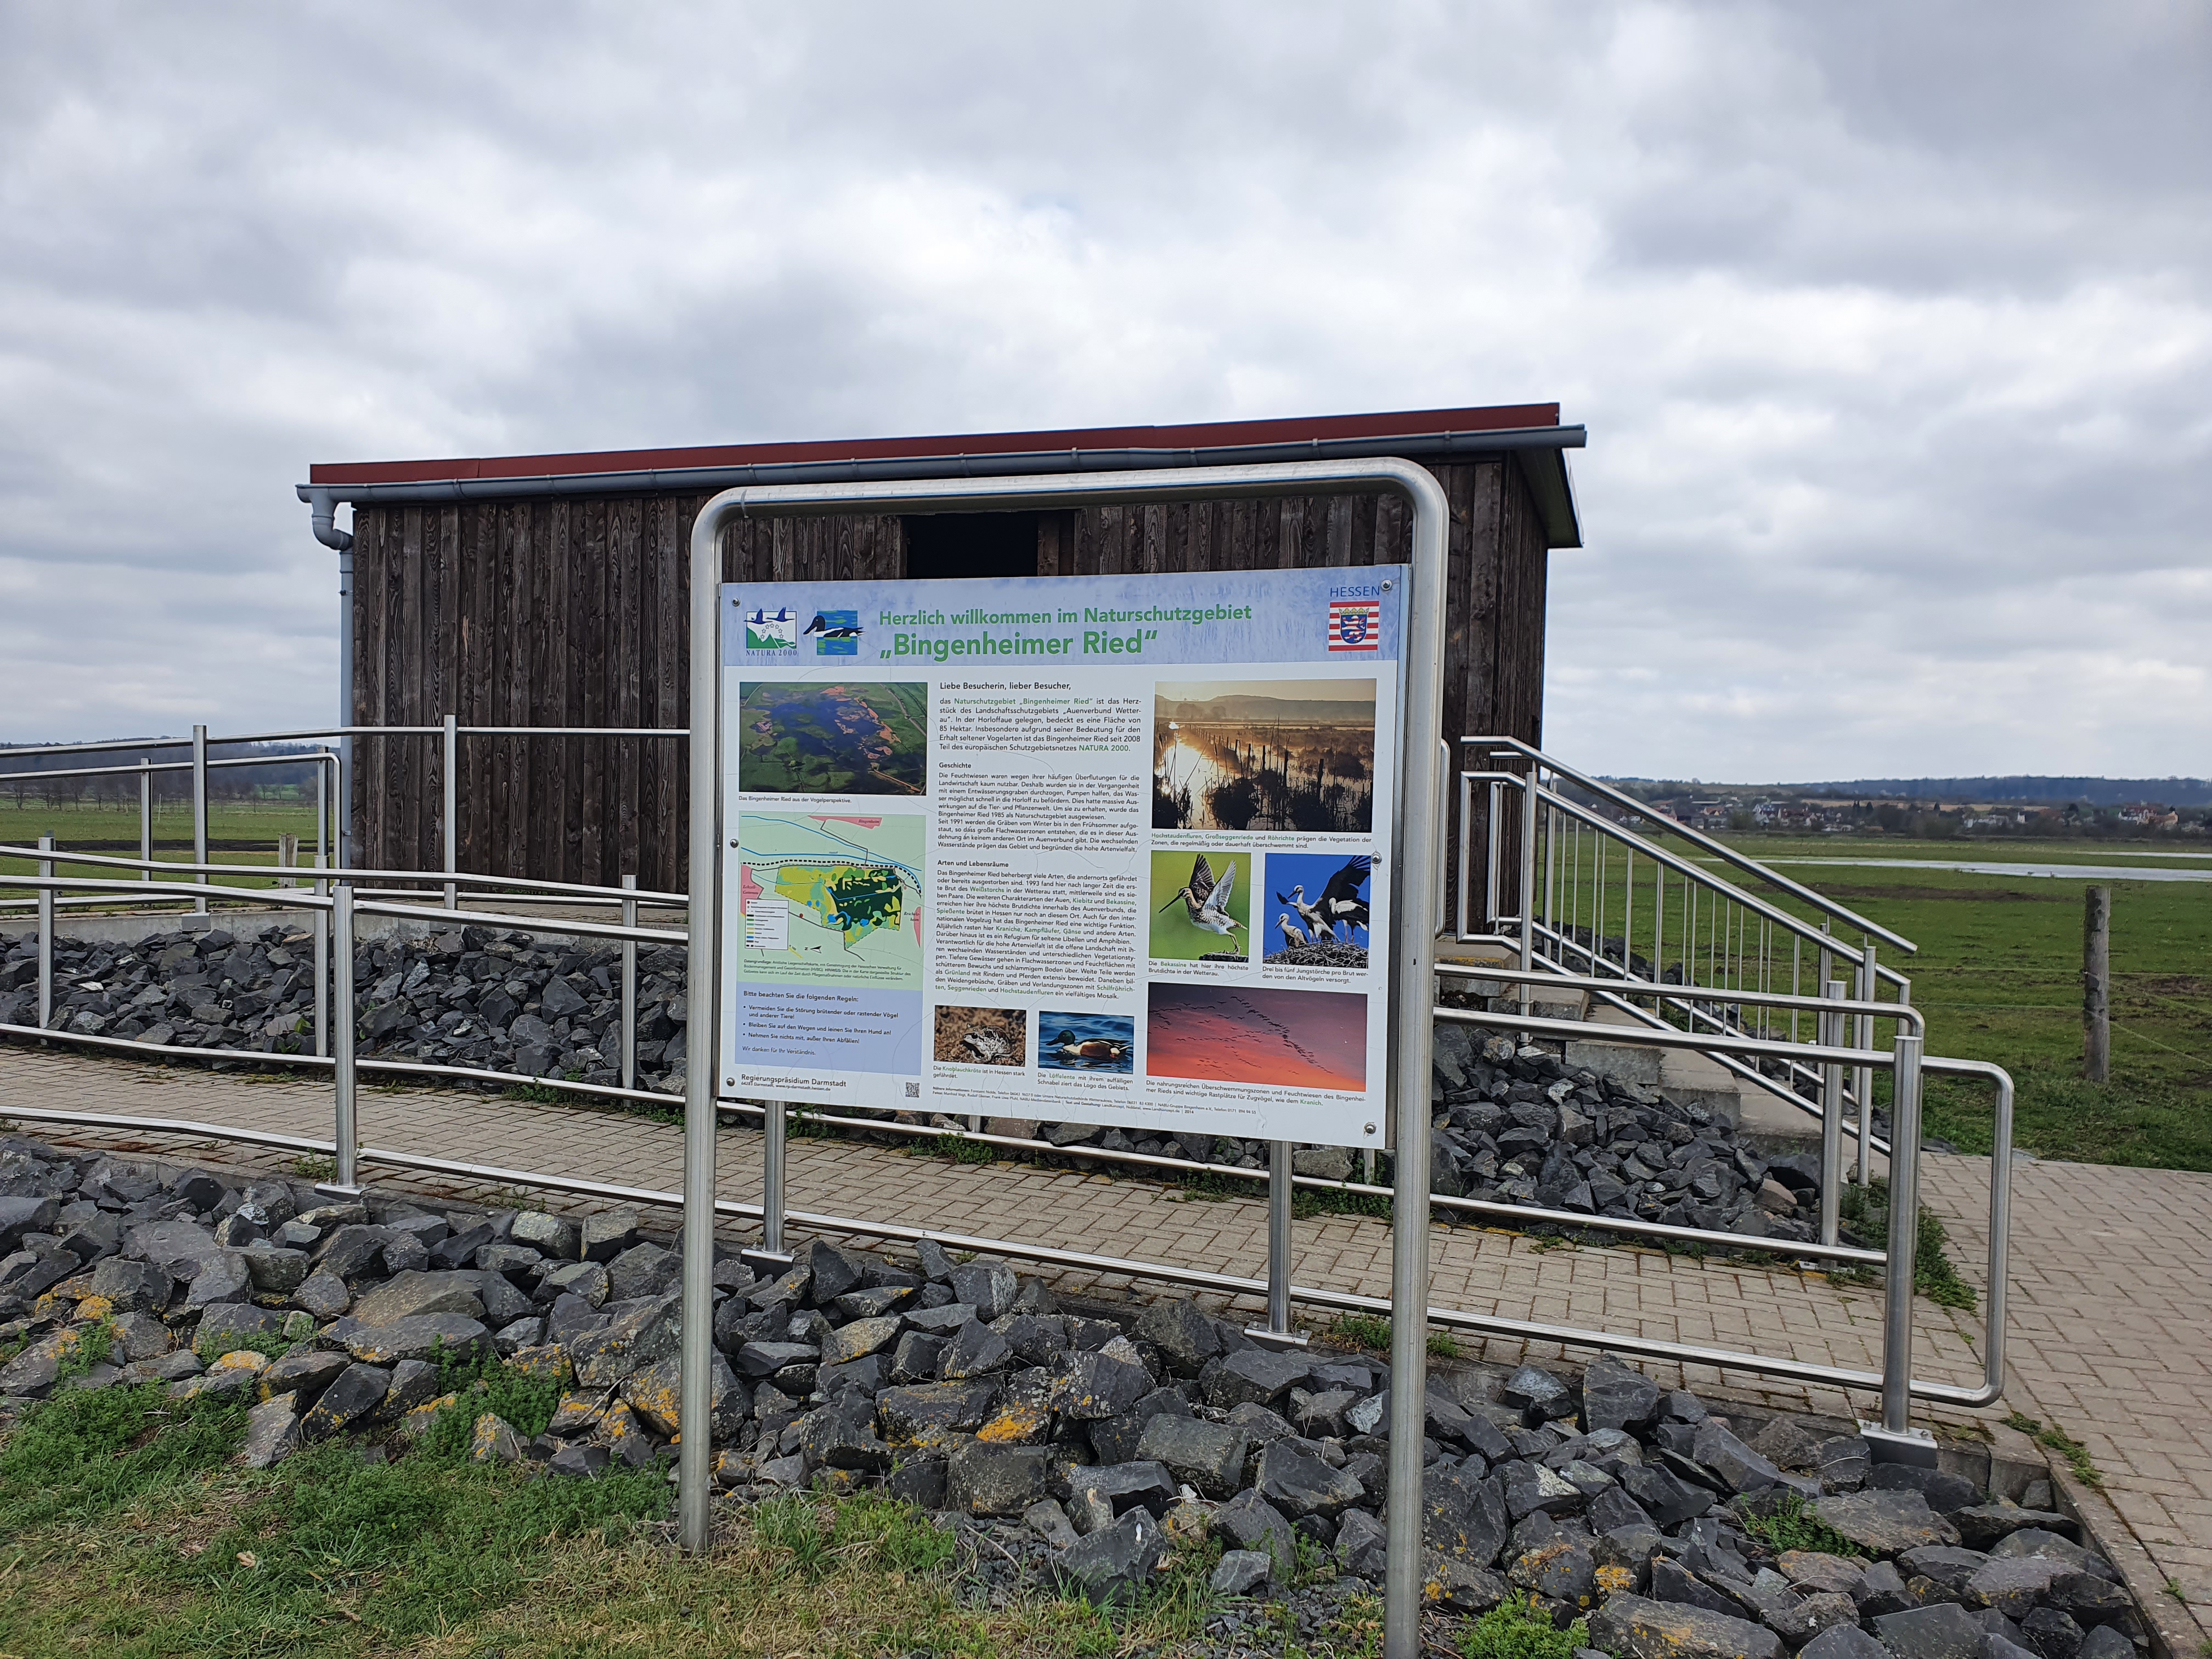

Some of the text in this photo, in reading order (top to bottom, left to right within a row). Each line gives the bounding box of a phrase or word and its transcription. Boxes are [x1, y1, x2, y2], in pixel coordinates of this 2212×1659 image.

[1330, 585, 1380, 597] HESSEN
[879, 605, 1252, 627] Herzlich willkommen im Naturschutzgebiet
[963, 682, 1007, 691] Besucherin,
[1034, 682, 1071, 691] Besucher,
[954, 698, 1016, 707] Naturschutzgebiet
[975, 707, 1059, 715] Landschaftsschutzgebiets
[1015, 716, 1043, 725] gelegen,
[1021, 725, 1051, 734] aufgrund
[1076, 725, 1113, 734] Bedeutung
[986, 734, 1022, 743] Vogelarten
[1046, 735, 1092, 743] Bingenheimer
[964, 743, 1007, 752] europäischen
[1009, 743, 1076, 753] Schutzgebietsnetzes
[1205, 833, 1254, 842] Großseggenriede
[1329, 836, 1360, 844] Vegetation
[1296, 967, 1330, 977] Jungstörche
[1297, 975, 1324, 984] Altvögeln
[806, 993, 836, 1002] folgenden
[942, 1065, 981, 1073] Knoblauchkröte
[741, 1074, 809, 1086] Regierungspräsidium
[811, 1078, 846, 1087] Darmstadt
[1156, 1080, 1201, 1091] nahrungsreichen
[1201, 1084, 1269, 1096] Überschwemmungszonen
[1284, 1090, 1322, 1098] Feuchtwiesen
[1185, 1090, 1207, 1098] wichtige
[1209, 1091, 1237, 1101] Rastplätze
